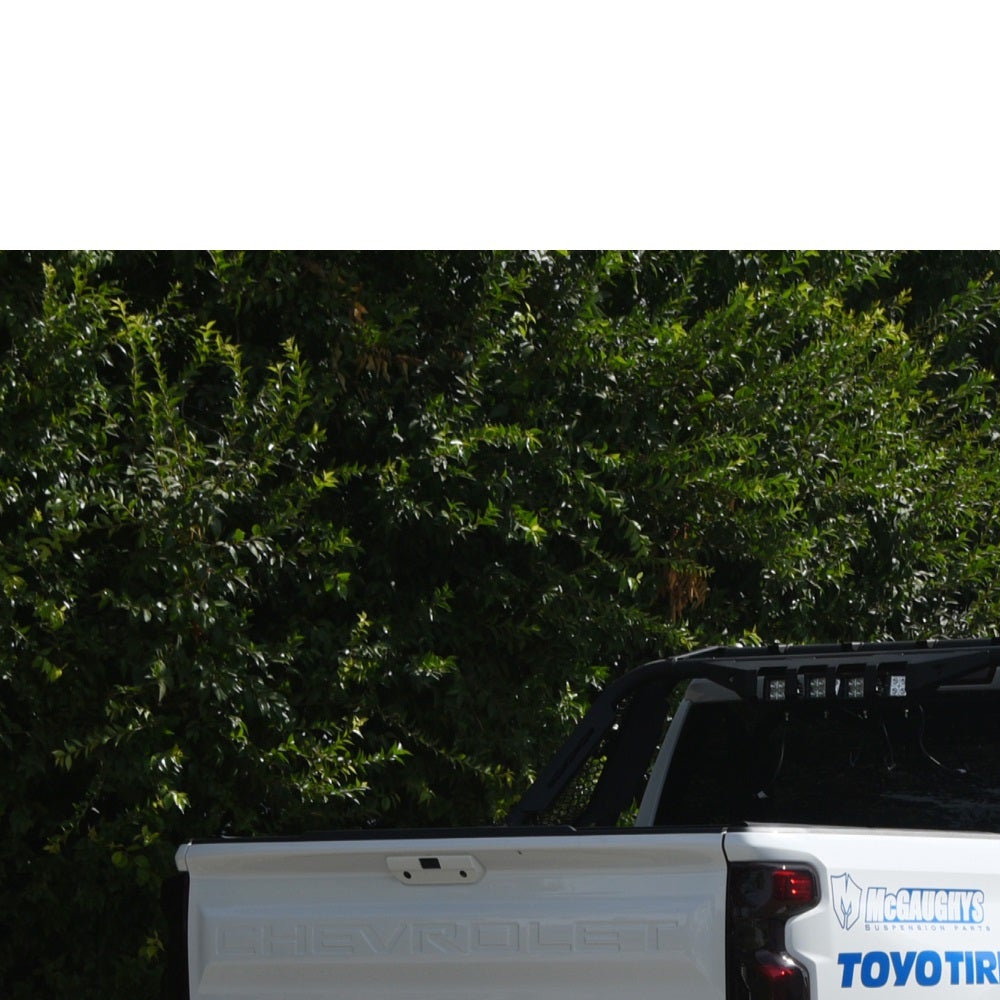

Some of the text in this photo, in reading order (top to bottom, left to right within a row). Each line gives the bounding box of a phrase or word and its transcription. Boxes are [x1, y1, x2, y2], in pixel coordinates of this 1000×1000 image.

[213, 919, 680, 957] CHEVROLET
[864, 924, 991, 932] SUSPENSION PARTS
[837, 950, 943, 988] TOYO
